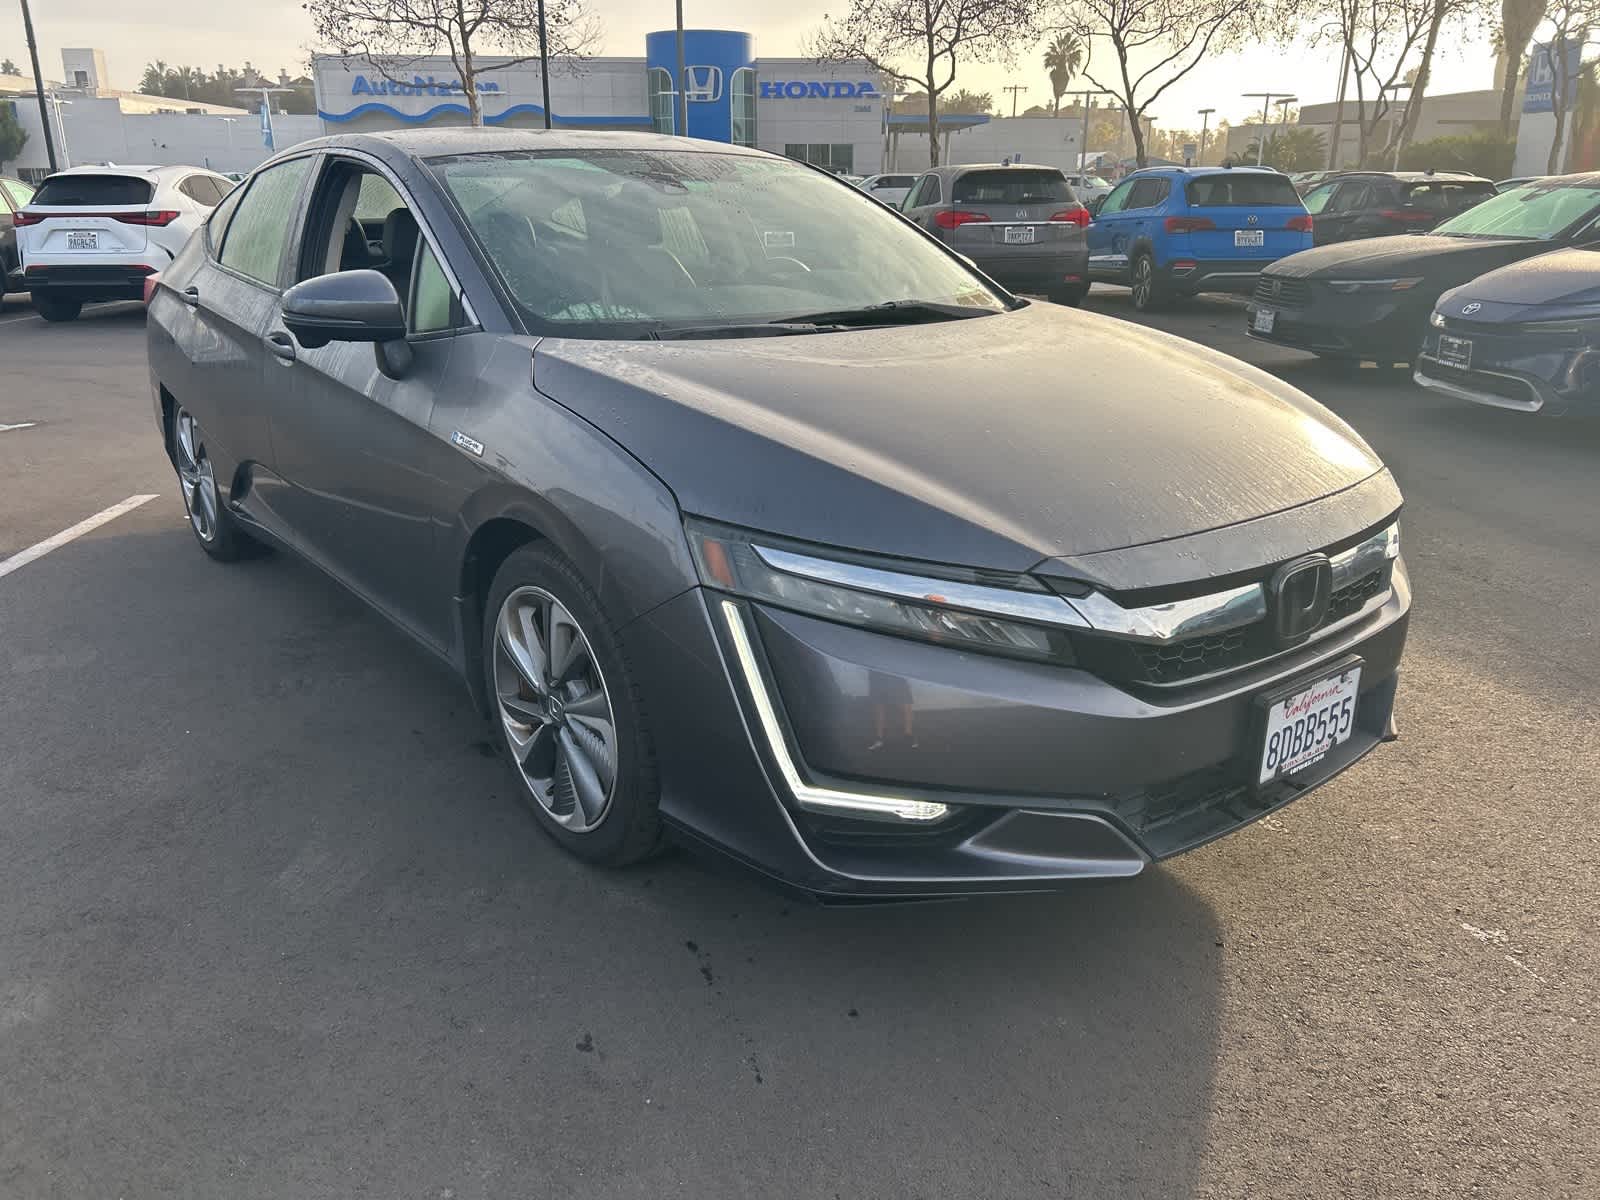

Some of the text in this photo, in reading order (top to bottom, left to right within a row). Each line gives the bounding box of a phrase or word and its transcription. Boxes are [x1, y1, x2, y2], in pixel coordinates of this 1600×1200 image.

[760, 81, 880, 99] HONDA
[1284, 684, 1343, 720] California
[1266, 696, 1352, 770] 8DBB555
